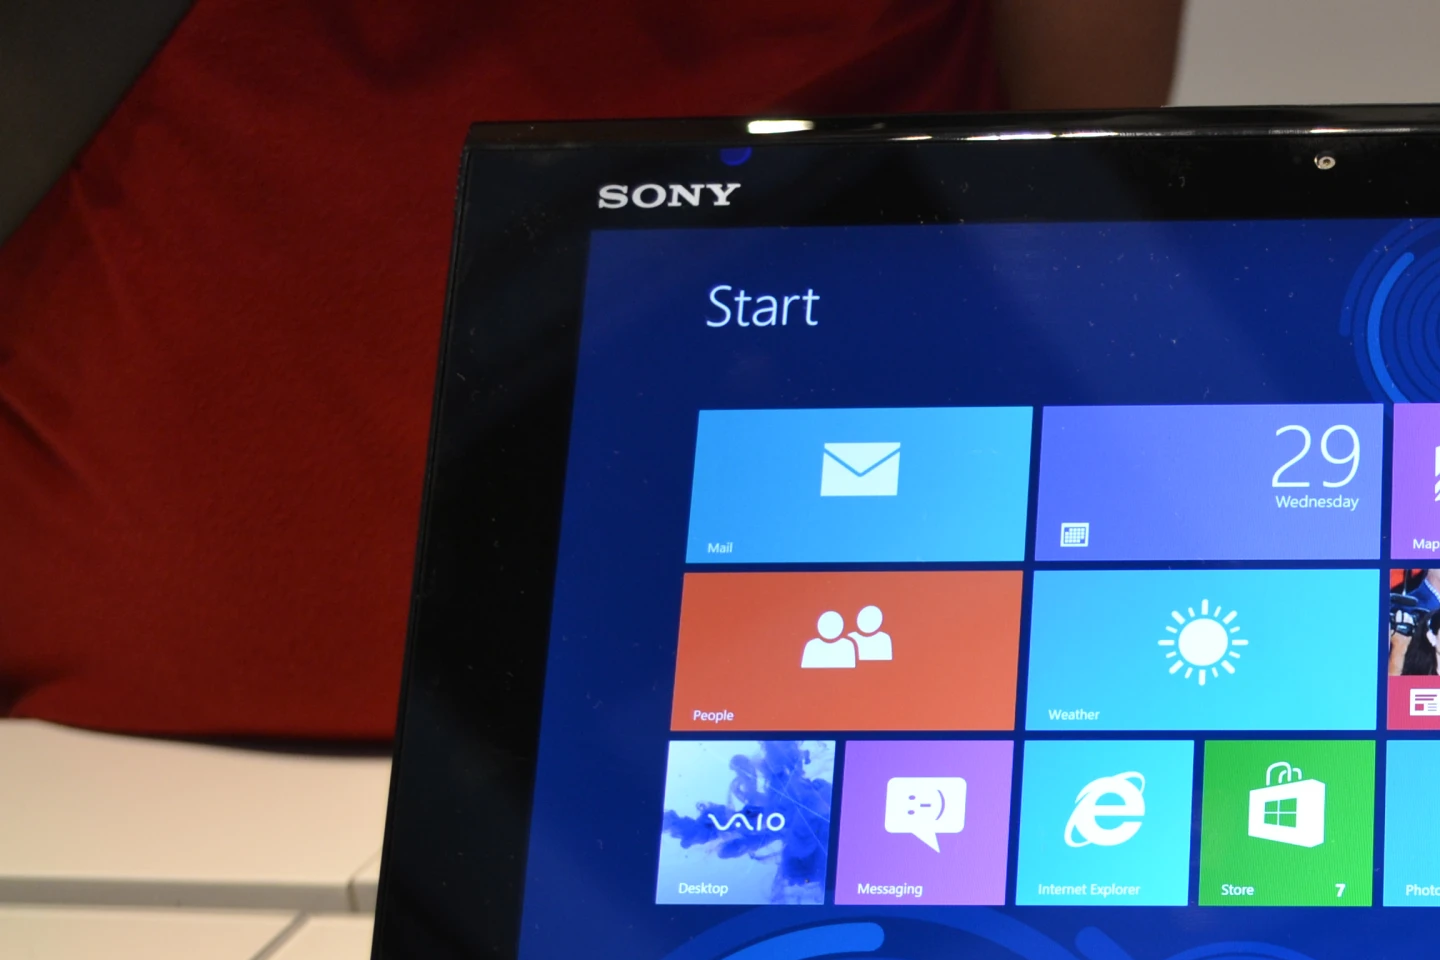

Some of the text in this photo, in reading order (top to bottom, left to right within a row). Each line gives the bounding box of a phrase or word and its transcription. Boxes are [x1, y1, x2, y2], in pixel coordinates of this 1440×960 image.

[598, 182, 741, 208] SONY
[705, 285, 820, 328] Start
[1271, 424, 1360, 487] 29
[1275, 493, 1359, 511] Wednesday
[707, 541, 733, 554] Mail
[693, 708, 734, 724] People
[1048, 708, 1100, 721] Weather
[708, 812, 785, 832] VAIO
[678, 882, 729, 897] Desktop
[857, 882, 923, 898] Messaging
[1037, 882, 1141, 898] Internet Explorer
[1221, 882, 1255, 895] Store
[1336, 882, 1346, 898] 7
